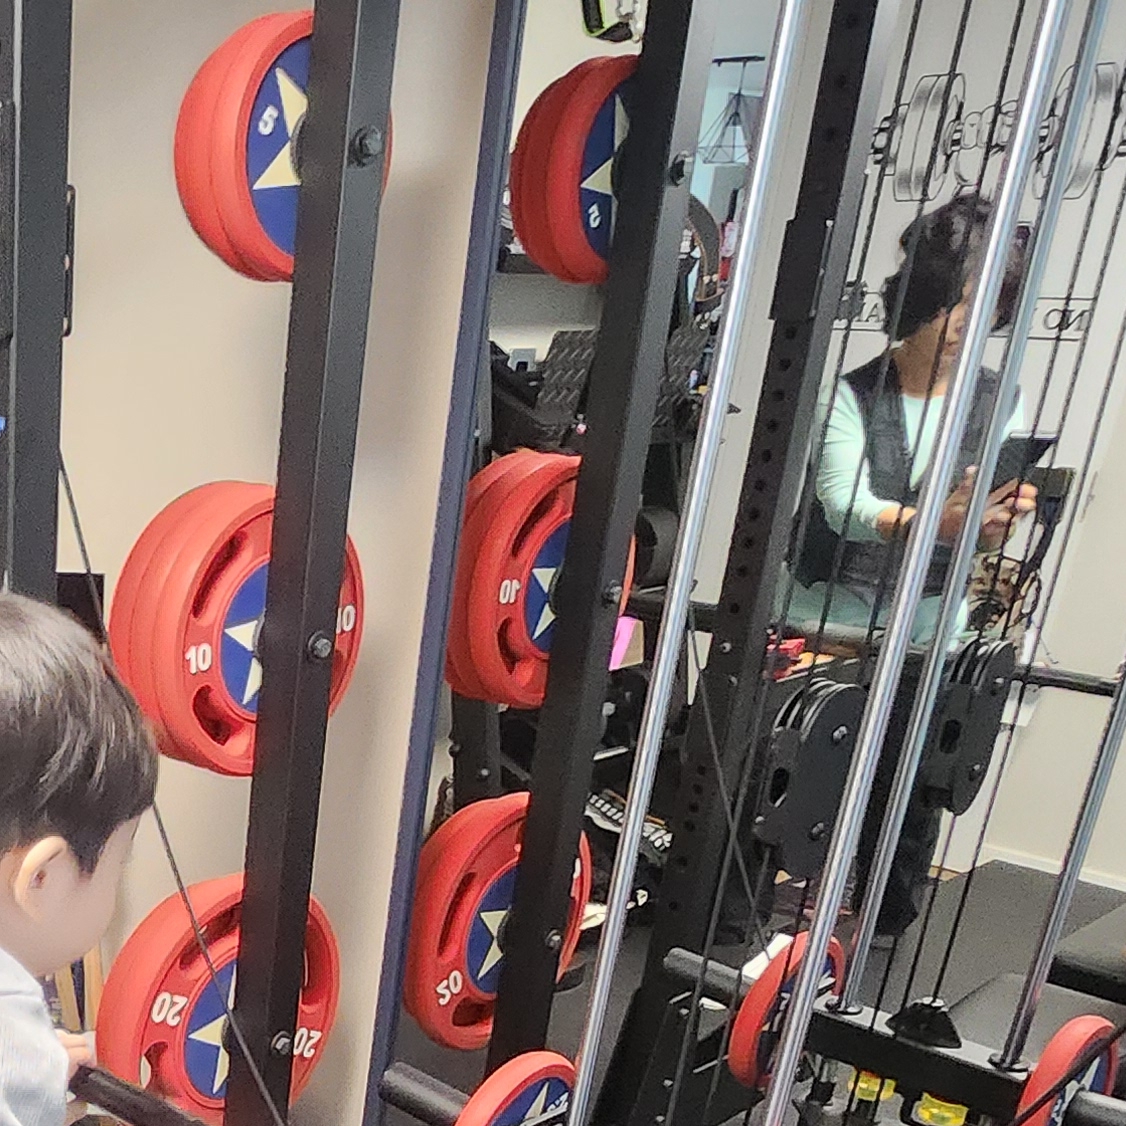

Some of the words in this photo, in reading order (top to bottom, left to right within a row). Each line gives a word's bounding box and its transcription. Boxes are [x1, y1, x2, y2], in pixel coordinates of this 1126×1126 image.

[258, 104, 279, 135] 5
[185, 643, 212, 674] 10
[151, 992, 188, 1026] 20
[293, 1027, 323, 1058] 20
